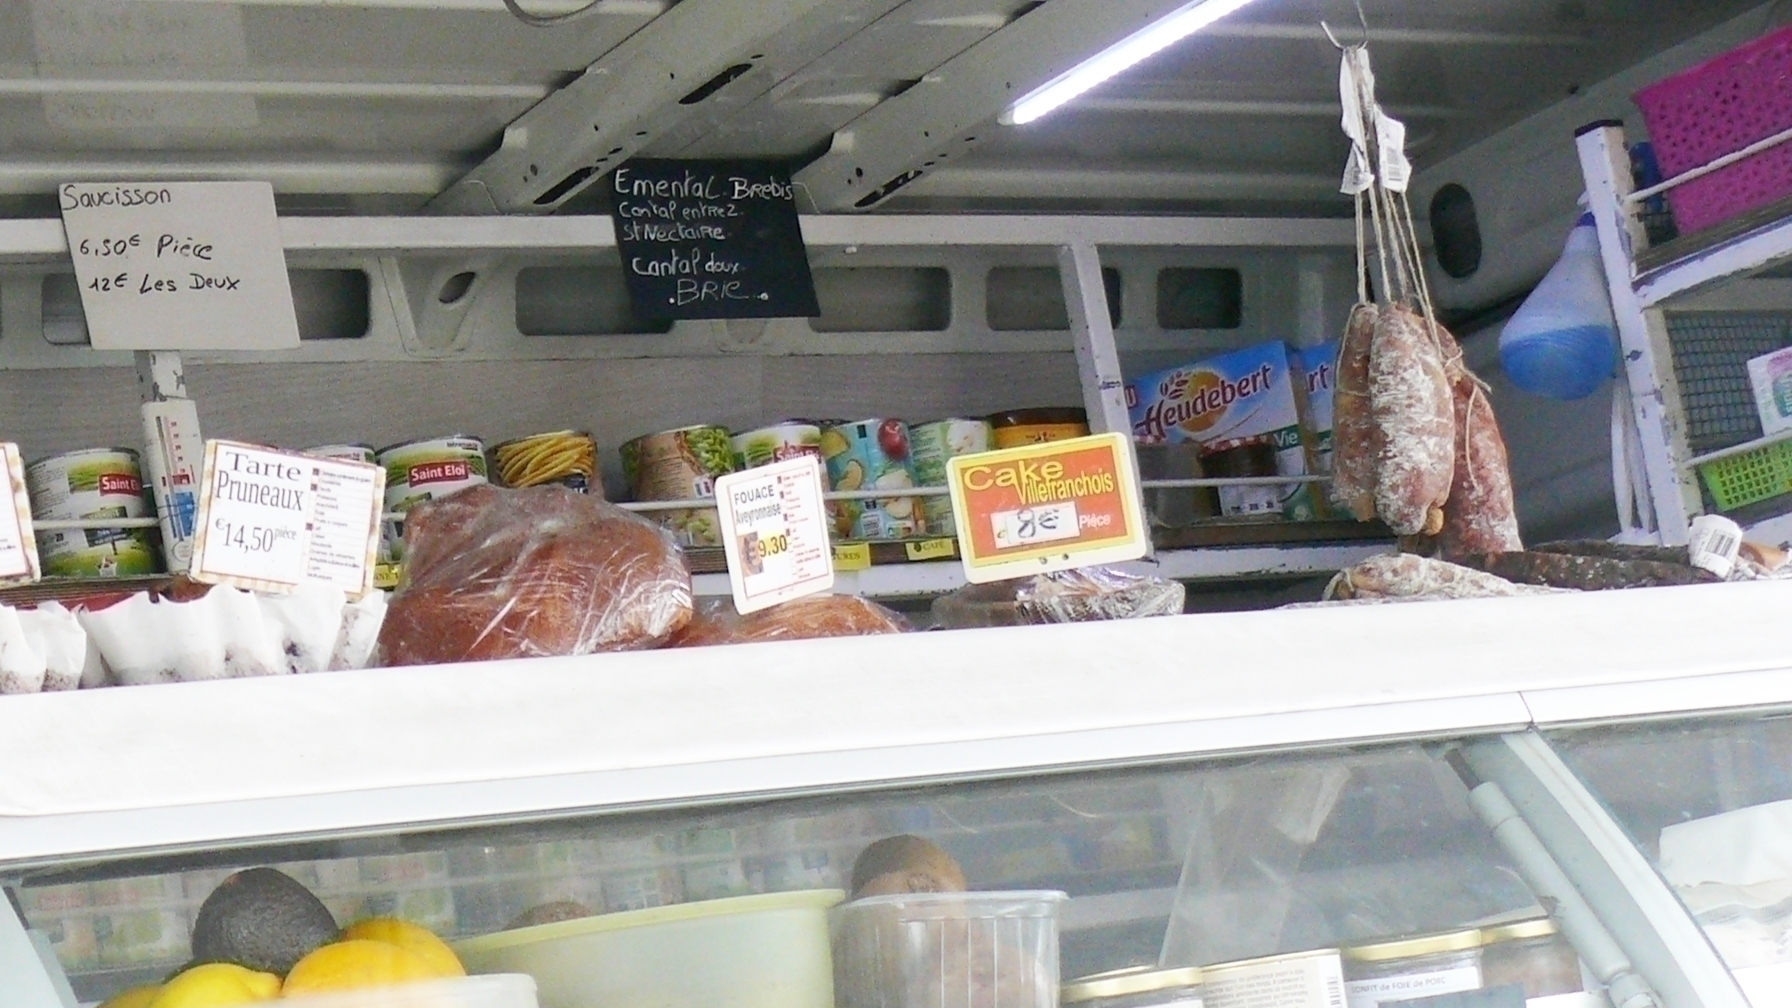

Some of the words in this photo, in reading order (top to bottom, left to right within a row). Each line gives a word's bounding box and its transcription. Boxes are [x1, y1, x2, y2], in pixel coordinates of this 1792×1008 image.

[60, 184, 172, 211] Saucisson
[704, 251, 741, 276] doux
[88, 272, 129, 292] 12€
[139, 273, 178, 295] Les
[189, 272, 241, 292] Deux
[1134, 362, 1273, 440] Heudebert
[1273, 431, 1298, 448] Vie
[226, 451, 302, 482] Tarte
[411, 467, 443, 482] Saint
[444, 463, 466, 478] Eloi
[101, 476, 130, 491] Saint
[215, 470, 305, 512] Pruneaux
[963, 460, 1064, 501] Cake
[1014, 467, 1114, 515] Villefranchois
[734, 484, 775, 506] FOUACE
[735, 503, 782, 528] Aveyronnaise
[1392, 980, 1412, 990] FOIE
